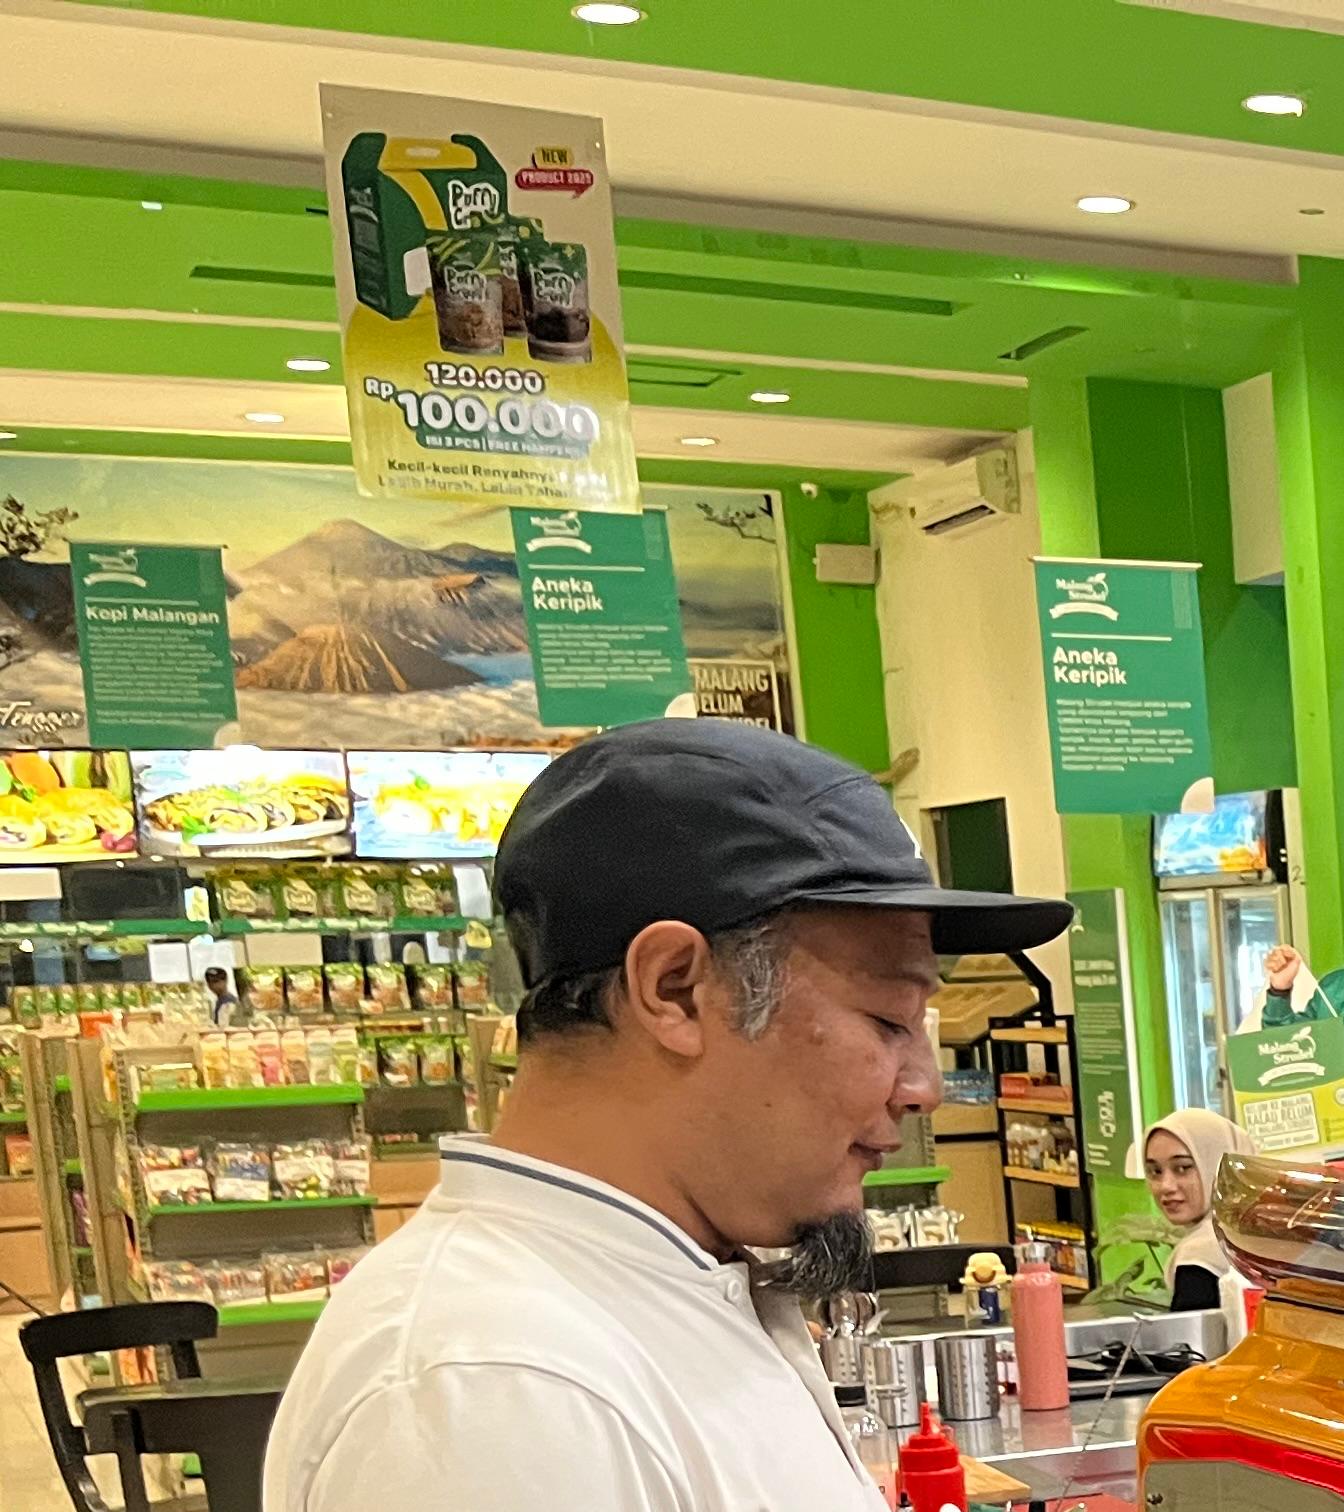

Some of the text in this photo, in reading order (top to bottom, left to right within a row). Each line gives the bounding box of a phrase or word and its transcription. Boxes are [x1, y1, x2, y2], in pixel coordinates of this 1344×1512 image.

[541, 150, 567, 163] NEW
[425, 363, 543, 393] 120.000
[365, 378, 394, 399] Rp
[398, 393, 599, 441] 100.000
[532, 577, 593, 594] Aneka
[534, 594, 603, 613] Keripik
[86, 606, 220, 625] Kopi Malangan
[1053, 646, 1118, 665] Aneka
[1054, 666, 1127, 687] Keripik
[694, 692, 744, 713] ELUM
